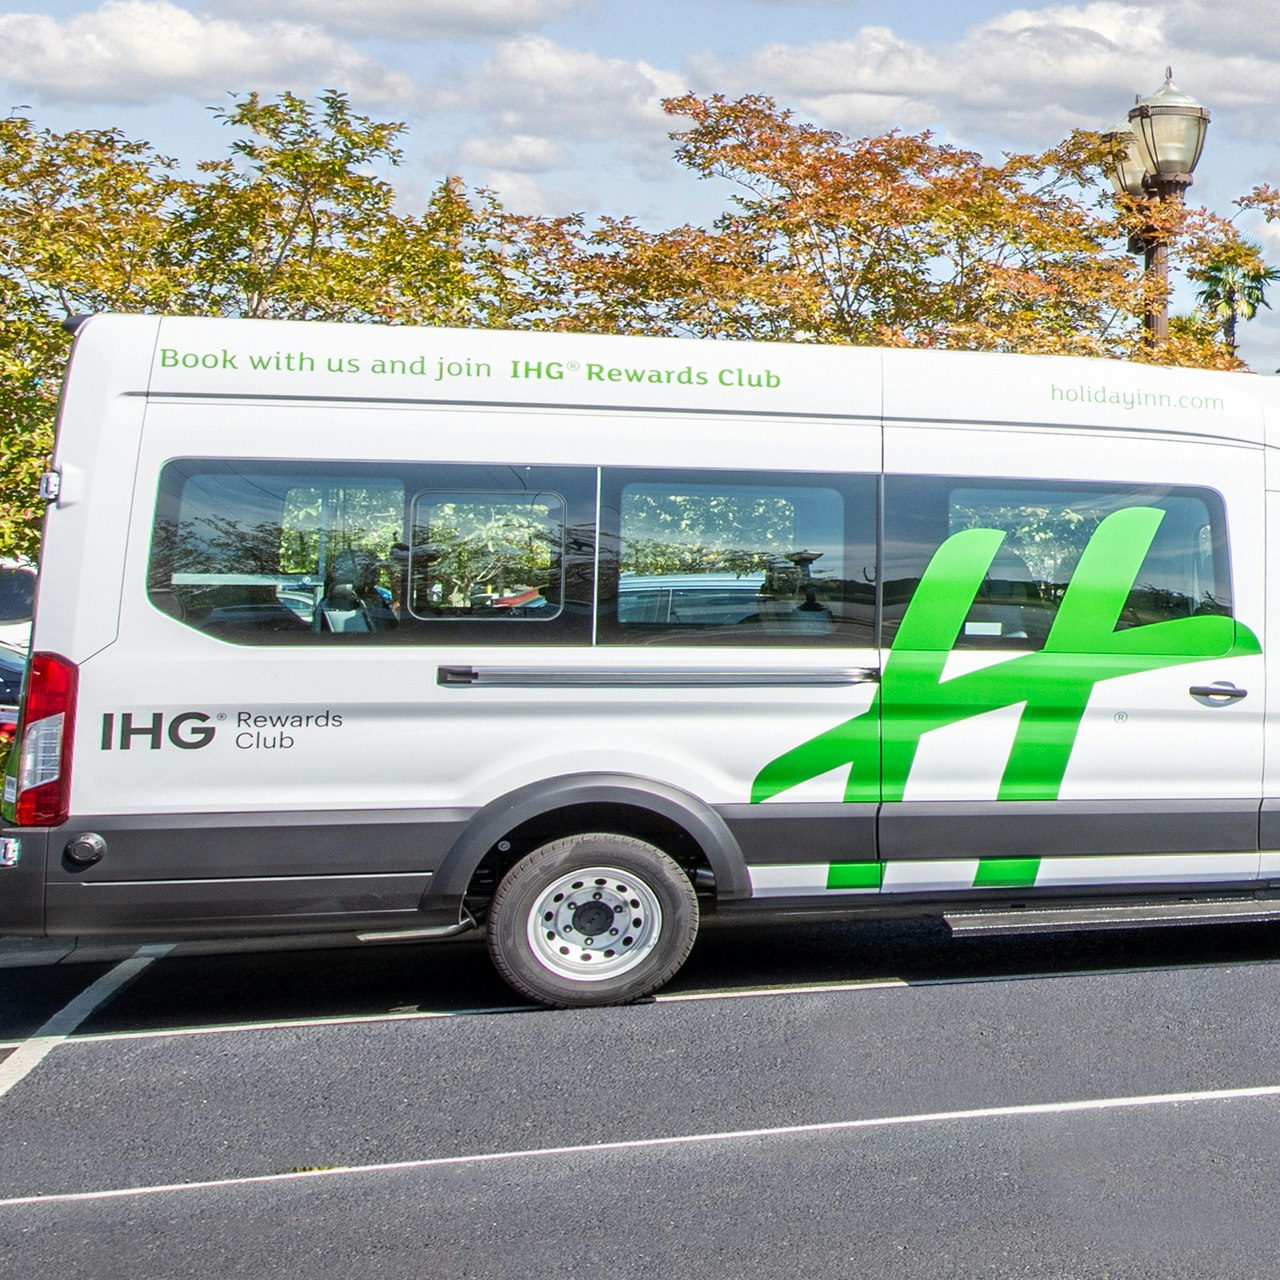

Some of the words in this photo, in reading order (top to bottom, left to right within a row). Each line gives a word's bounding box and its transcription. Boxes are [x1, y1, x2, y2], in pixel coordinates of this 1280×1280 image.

[160, 348, 239, 370] Book
[249, 351, 315, 372] with
[327, 358, 360, 374] us
[371, 356, 426, 376] and
[434, 356, 492, 382] join
[586, 363, 709, 386] Rewards
[718, 368, 781, 389] Club
[1051, 383, 1225, 411] holidayinn.com
[236, 710, 343, 728] Rewards
[235, 731, 295, 750] Club
